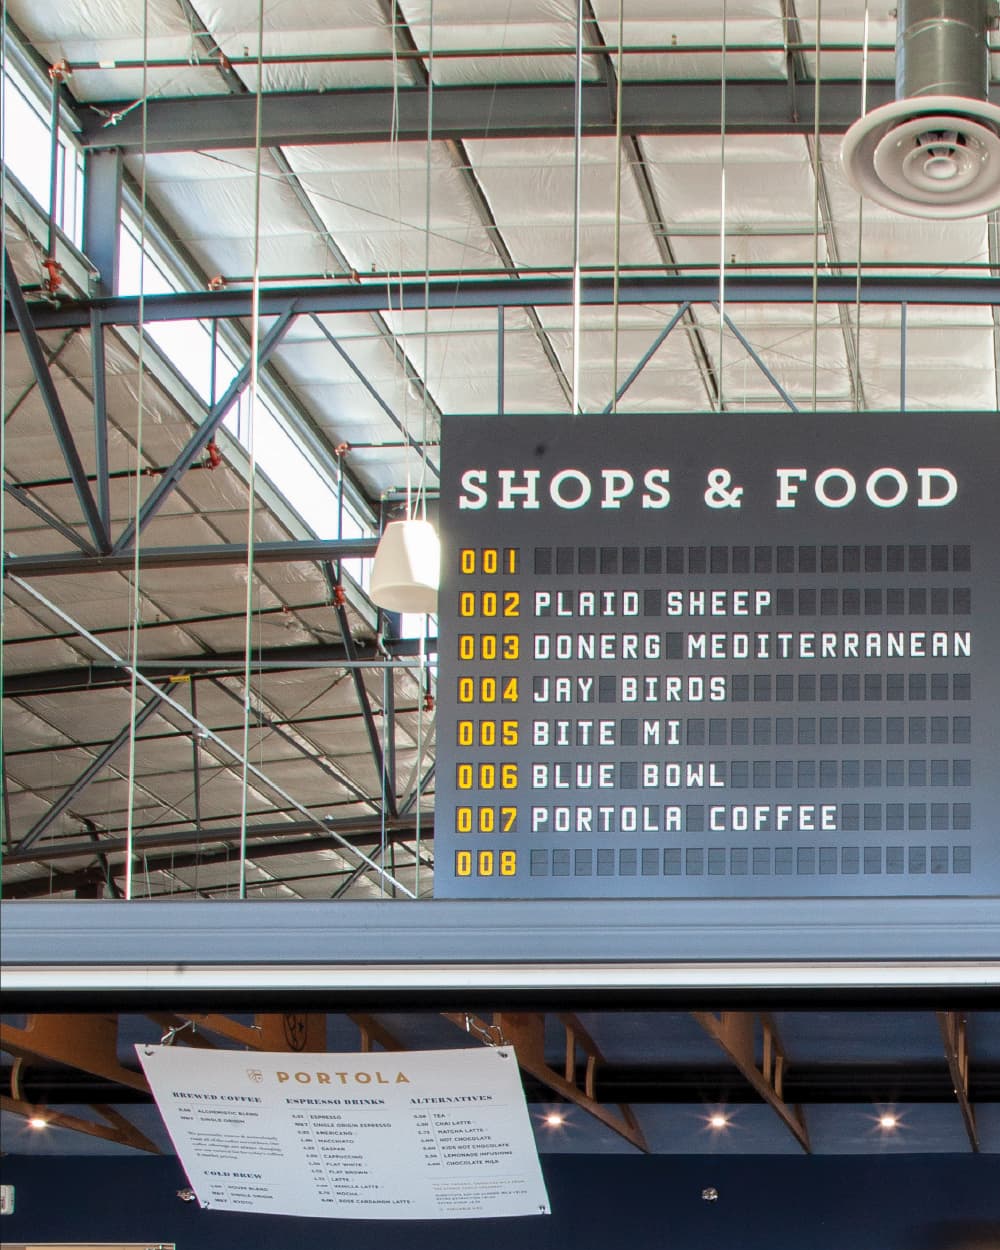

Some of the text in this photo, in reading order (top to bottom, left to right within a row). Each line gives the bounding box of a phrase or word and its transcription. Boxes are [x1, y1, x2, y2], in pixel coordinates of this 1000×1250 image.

[459, 468, 957, 509] SHOPS & FOOD
[462, 550, 514, 573] 001
[462, 591, 770, 616] 002 PLAID SHEEP
[461, 633, 970, 659] 003 DONERG MEDITERRANEAN
[460, 677, 725, 701] 004 JAY BIRDS
[460, 721, 679, 745] 005 BITE MI
[459, 764, 724, 788] 006 BLUE BOWL
[458, 806, 836, 833] 007 PORTOLA COFFEE
[458, 849, 518, 877] 008
[277, 1071, 410, 1084] PORTOLA
[172, 1092, 217, 1100] BREWED
[410, 1095, 492, 1104] ALTERNATIVES
